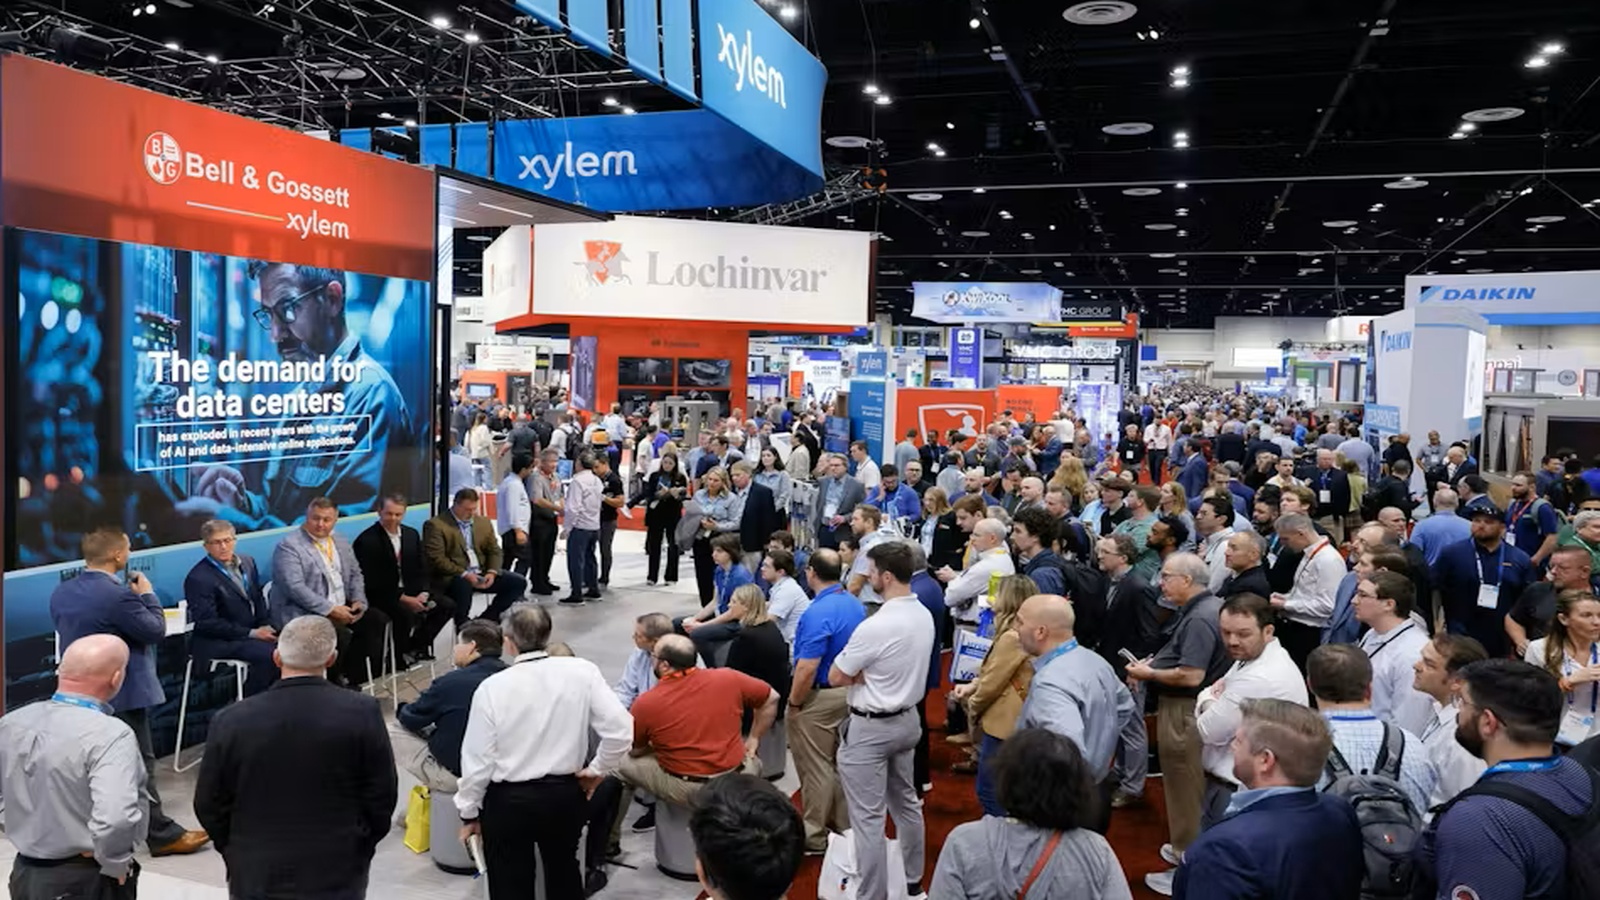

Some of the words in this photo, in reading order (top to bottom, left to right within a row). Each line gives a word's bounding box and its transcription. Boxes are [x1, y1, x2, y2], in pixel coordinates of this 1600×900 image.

[717, 23, 787, 109] xylem
[186, 151, 234, 185] Bell
[242, 164, 259, 191] &
[267, 170, 350, 209] Gossett
[518, 141, 638, 190] xylem
[286, 209, 350, 240] xylem
[646, 250, 829, 294] Lochinvar
[1440, 286, 1536, 302] DAIKIN
[148, 350, 209, 383] The
[218, 352, 327, 383] demand
[331, 355, 364, 382] for
[1058, 345, 1121, 360] GROUP
[176, 386, 243, 419] data
[250, 390, 345, 417] centers
[159, 431, 179, 444] has
[180, 426, 228, 447] exploded
[230, 426, 239, 439] in
[241, 426, 270, 439] recent
[272, 426, 295, 441] years
[297, 423, 314, 435] with
[316, 422, 330, 434] the
[331, 421, 357, 436] growth
[160, 446, 173, 459] of
[174, 444, 187, 457] AI
[189, 442, 209, 456] and
[210, 438, 278, 454] data-intensive
[279, 435, 304, 449] online
